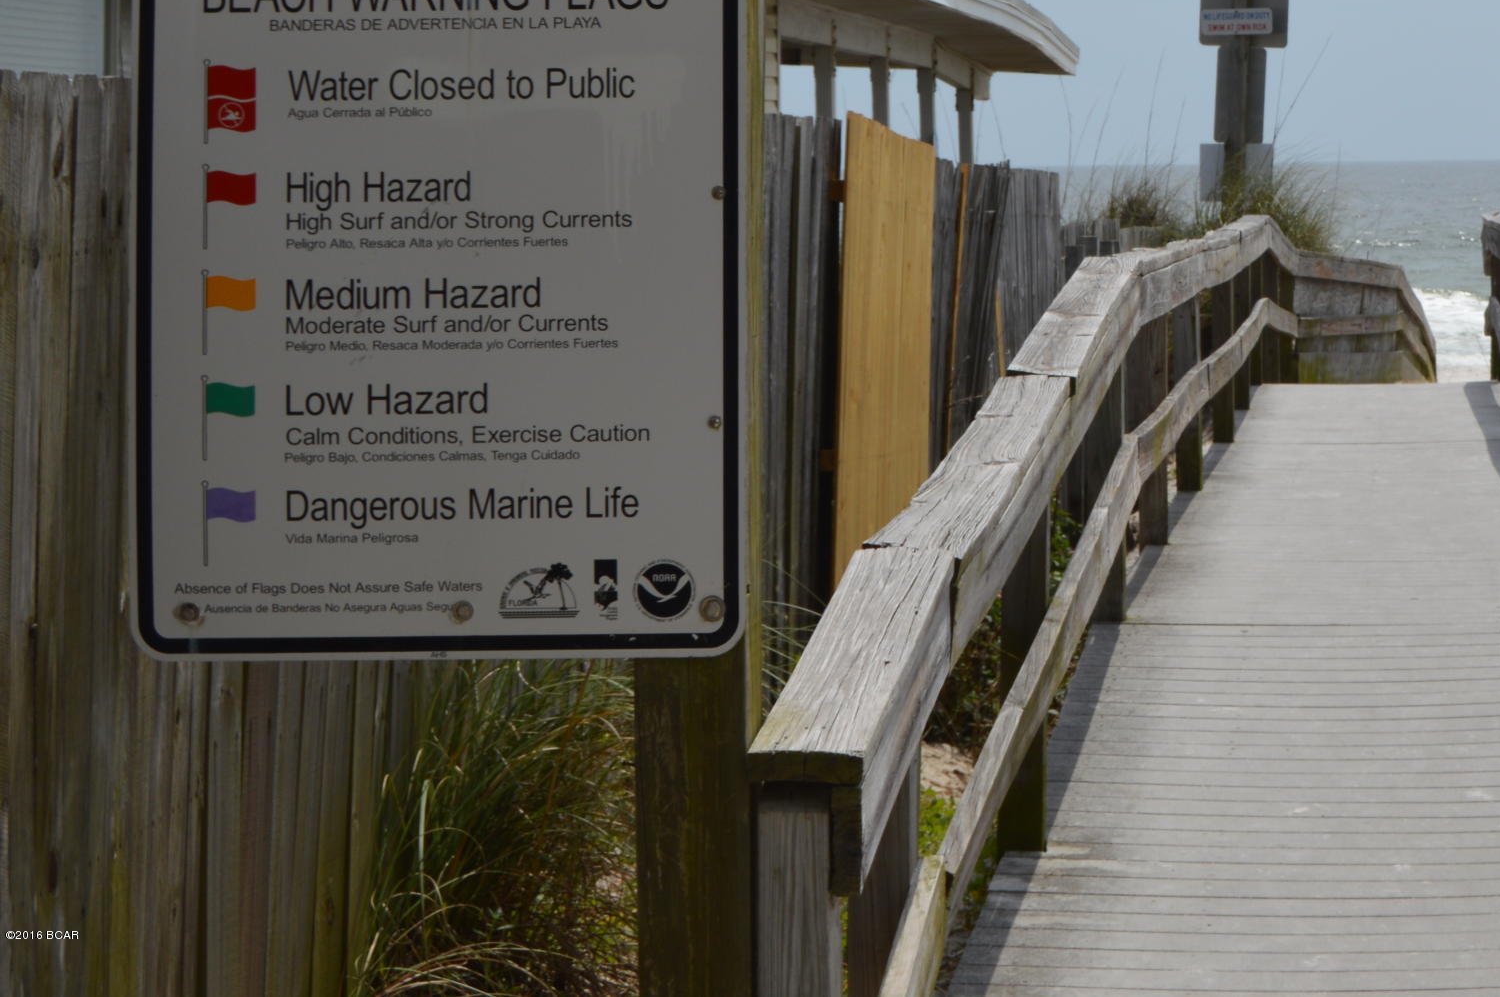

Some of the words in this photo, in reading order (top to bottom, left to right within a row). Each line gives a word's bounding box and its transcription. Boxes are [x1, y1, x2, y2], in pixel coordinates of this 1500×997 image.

[269, 18, 356, 31] BANDERAS
[360, 18, 382, 31] DE
[386, 17, 497, 30] ADVERTENCIA
[502, 17, 523, 29] EN
[528, 17, 548, 29] LA
[553, 16, 601, 29] PLAYA
[287, 69, 379, 101] Water
[389, 68, 494, 100] Closed
[506, 69, 533, 99] to
[546, 67, 635, 99] Public
[287, 107, 319, 121] Agua
[322, 106, 371, 118] Cerrada
[374, 106, 385, 117] al
[286, 171, 350, 211] High
[363, 170, 470, 202] Hazard
[286, 212, 331, 235] High
[339, 211, 384, 230] Surf
[390, 210, 457, 230] and/or
[464, 210, 534, 233] Strong
[542, 209, 632, 228] Currents
[286, 278, 410, 310] Medium
[425, 276, 540, 309] Hazard
[285, 384, 353, 416] Low
[367, 382, 487, 415] Hazard
[285, 427, 339, 446] Calm
[347, 426, 462, 445] Conditions,
[472, 425, 562, 443] Exercise
[569, 424, 649, 442] Caution
[286, 489, 456, 529] Dangerous
[469, 487, 573, 519] Marine
[586, 485, 638, 518] Life
[284, 533, 312, 544] Vida
[316, 532, 358, 544] Marina
[361, 532, 418, 545] Peligrosa
[173, 582, 232, 595] Absence
[234, 582, 248, 594] of
[251, 582, 287, 596] Flags
[290, 582, 325, 594] Does
[328, 582, 351, 593] Not
[354, 581, 400, 593] Assure
[404, 580, 433, 593] Safe
[437, 580, 482, 592] Waters
[203, 604, 253, 616] Ausencia
[255, 603, 269, 613] de
[271, 603, 322, 613] Banderas
[324, 602, 340, 612] No
[342, 602, 387, 614] Asegura
[390, 602, 422, 613] Aguas
